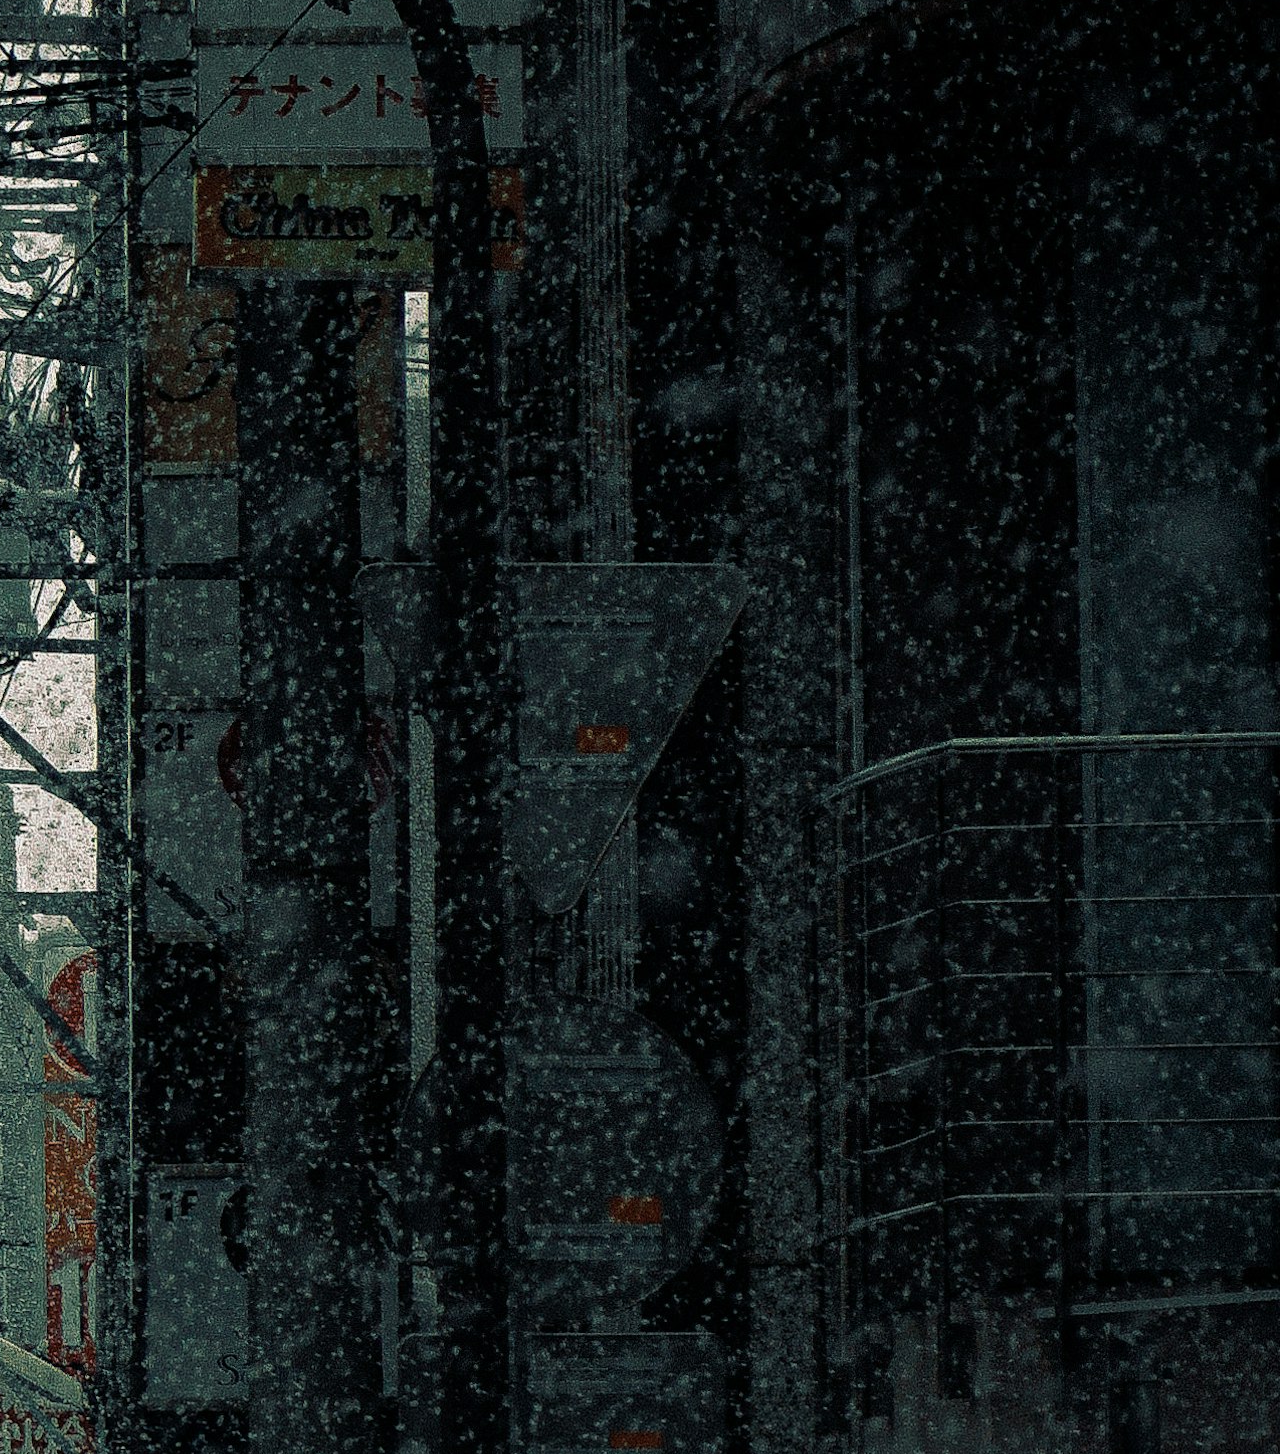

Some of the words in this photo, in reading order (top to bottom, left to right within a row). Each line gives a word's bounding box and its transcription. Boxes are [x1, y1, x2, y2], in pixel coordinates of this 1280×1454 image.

[229, 74, 501, 119] テナント集
[220, 192, 374, 241] China
[155, 722, 195, 752] 2F
